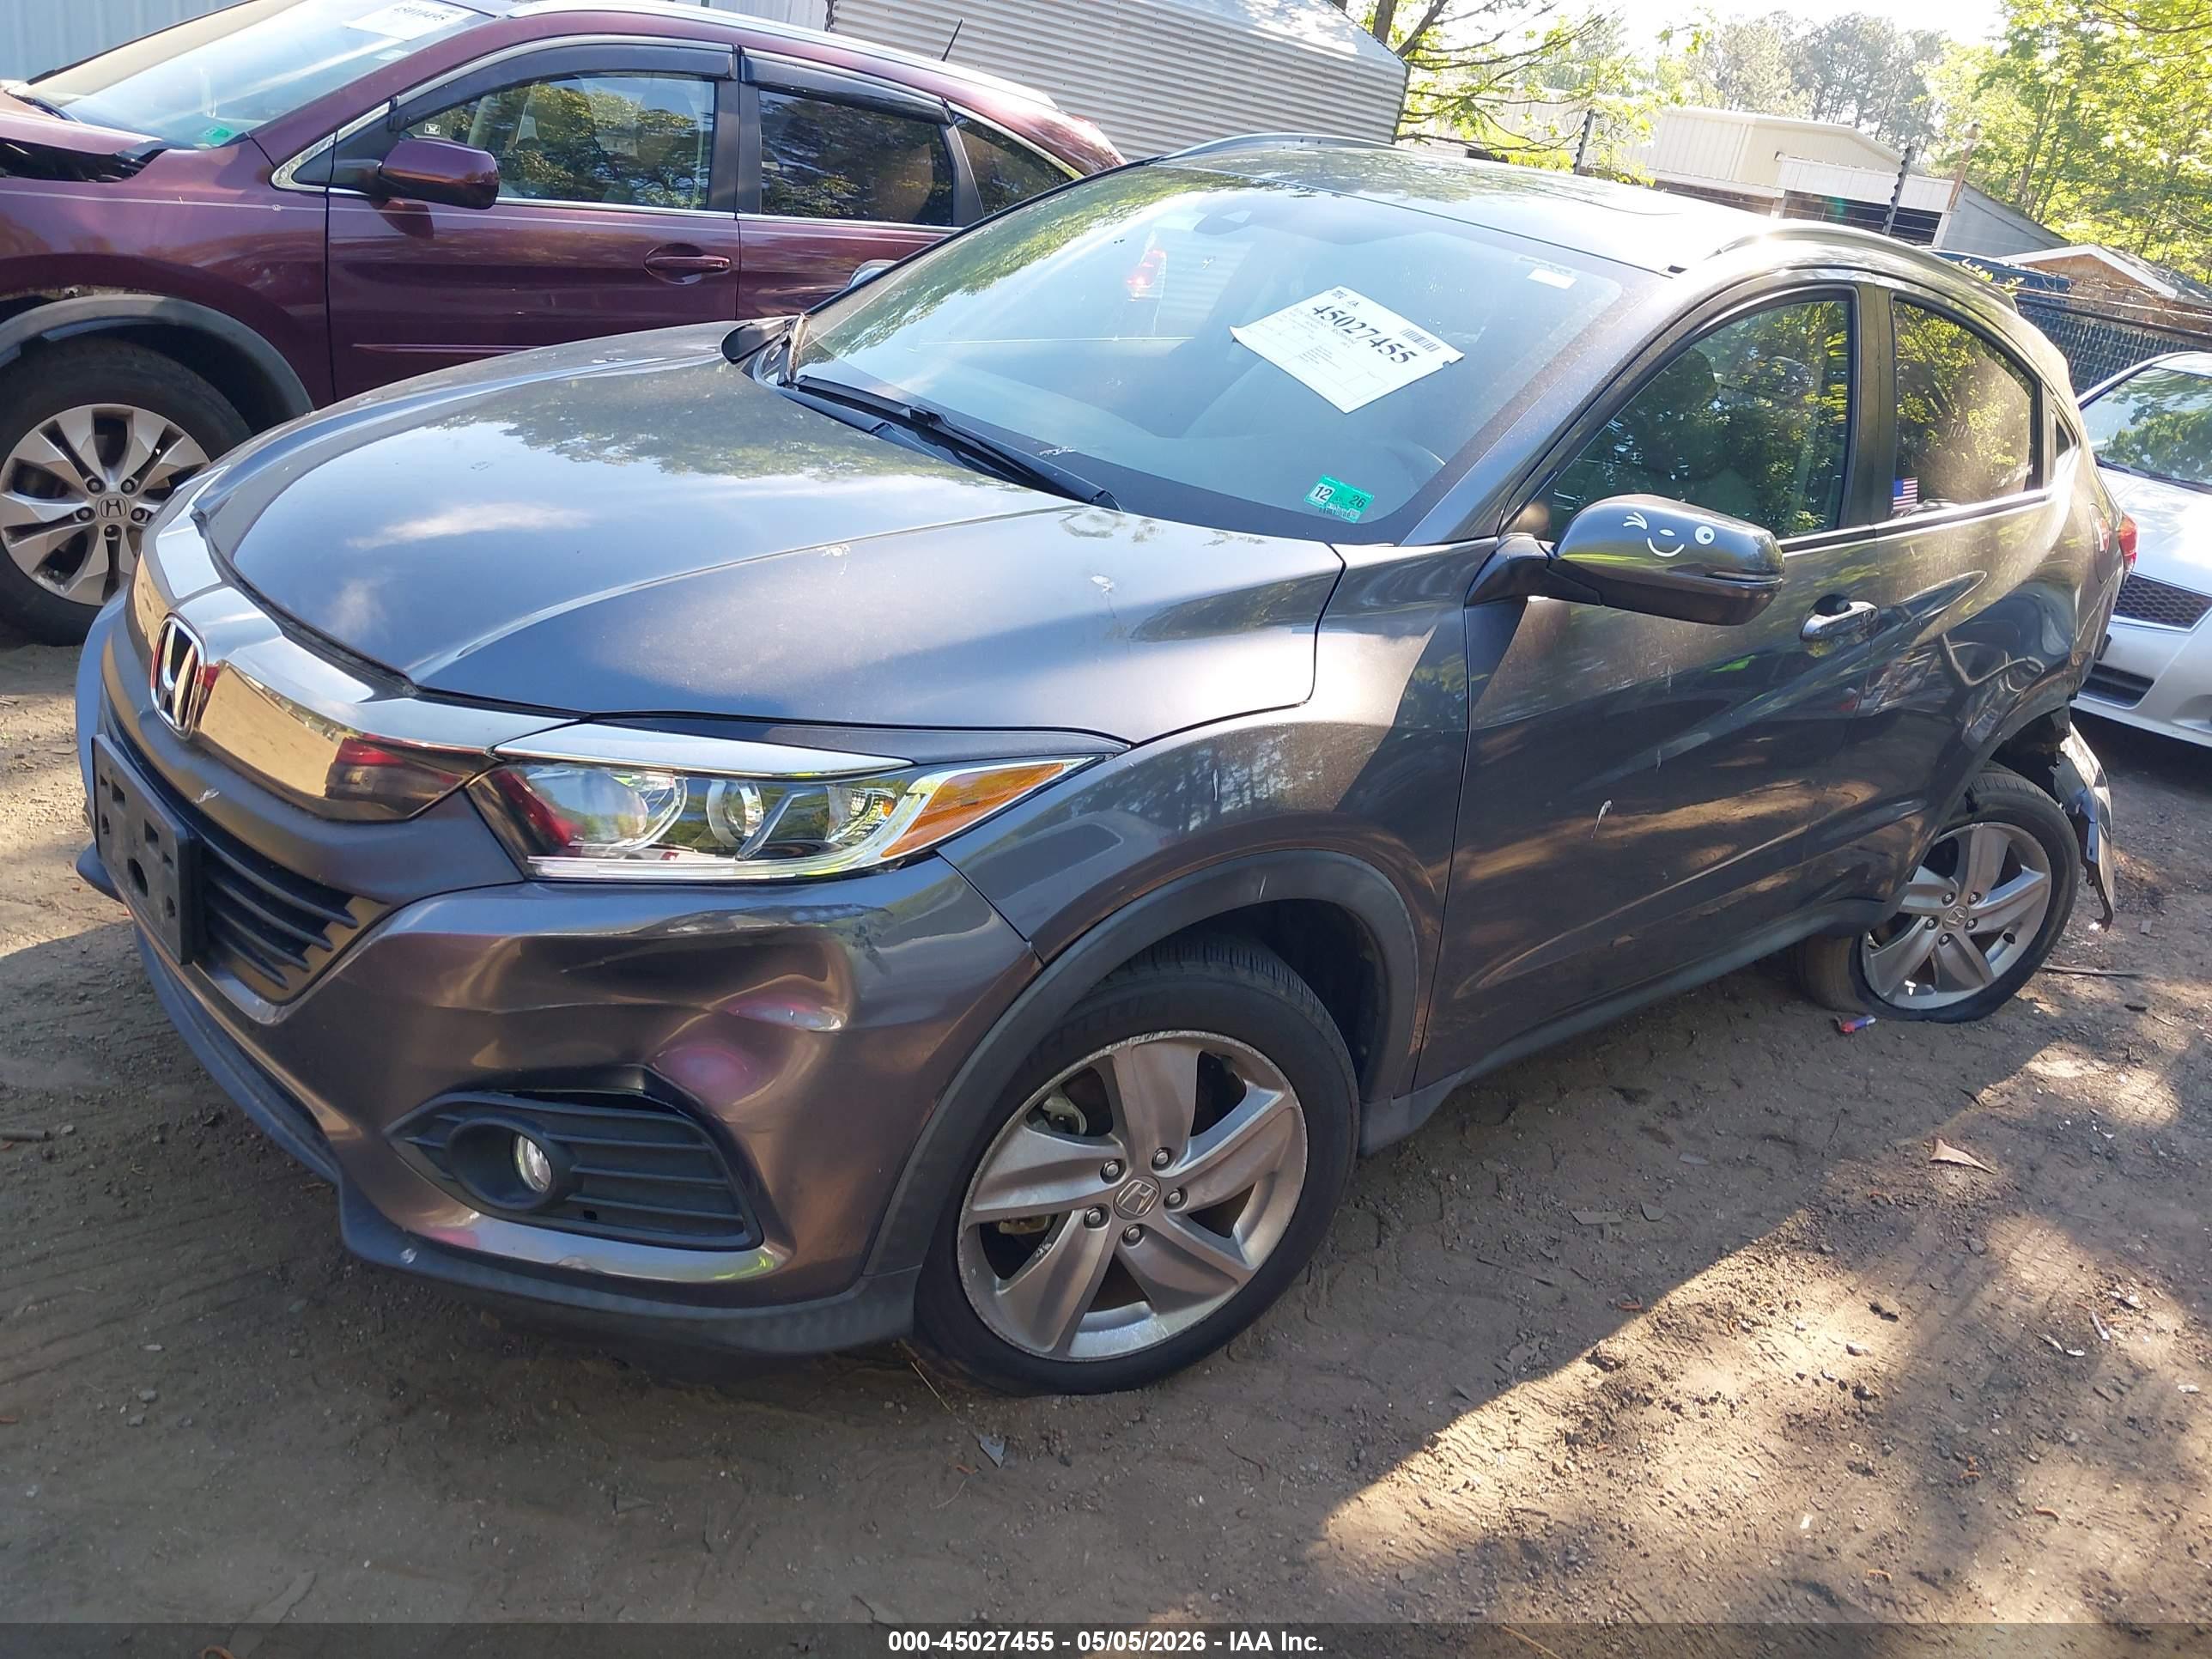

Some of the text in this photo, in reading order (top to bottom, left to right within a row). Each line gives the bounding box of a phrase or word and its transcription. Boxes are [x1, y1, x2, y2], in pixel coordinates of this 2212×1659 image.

[1312, 305, 1419, 364] 45027455
[1315, 485, 1367, 508] 12 26
